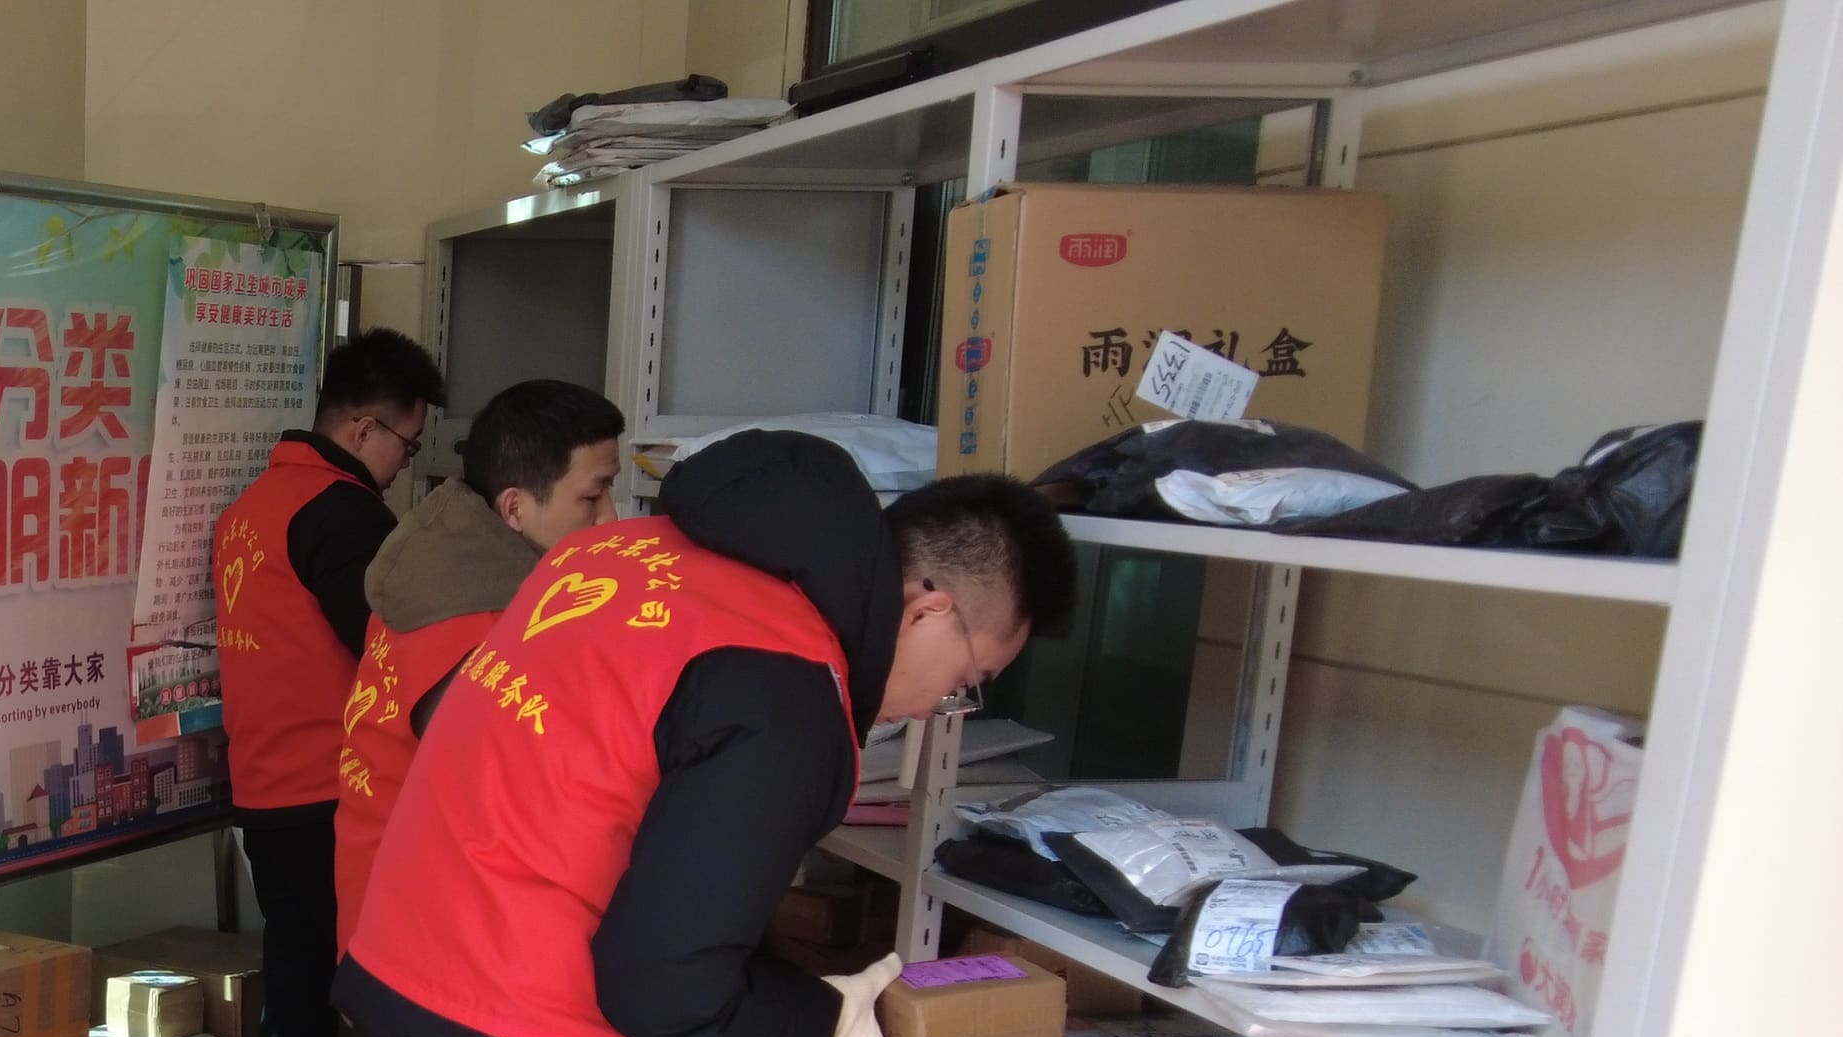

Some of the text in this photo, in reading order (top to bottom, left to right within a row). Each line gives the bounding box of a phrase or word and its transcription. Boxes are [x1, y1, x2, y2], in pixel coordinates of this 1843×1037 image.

[1068, 238, 1119, 260] 雨润
[185, 267, 308, 299] 巩固国家卫生城市成果
[196, 301, 293, 328] 享受健康美好生活
[1082, 327, 1313, 379] 雨礼盒
[35, 704, 48, 724] by
[49, 696, 102, 719] everybody
